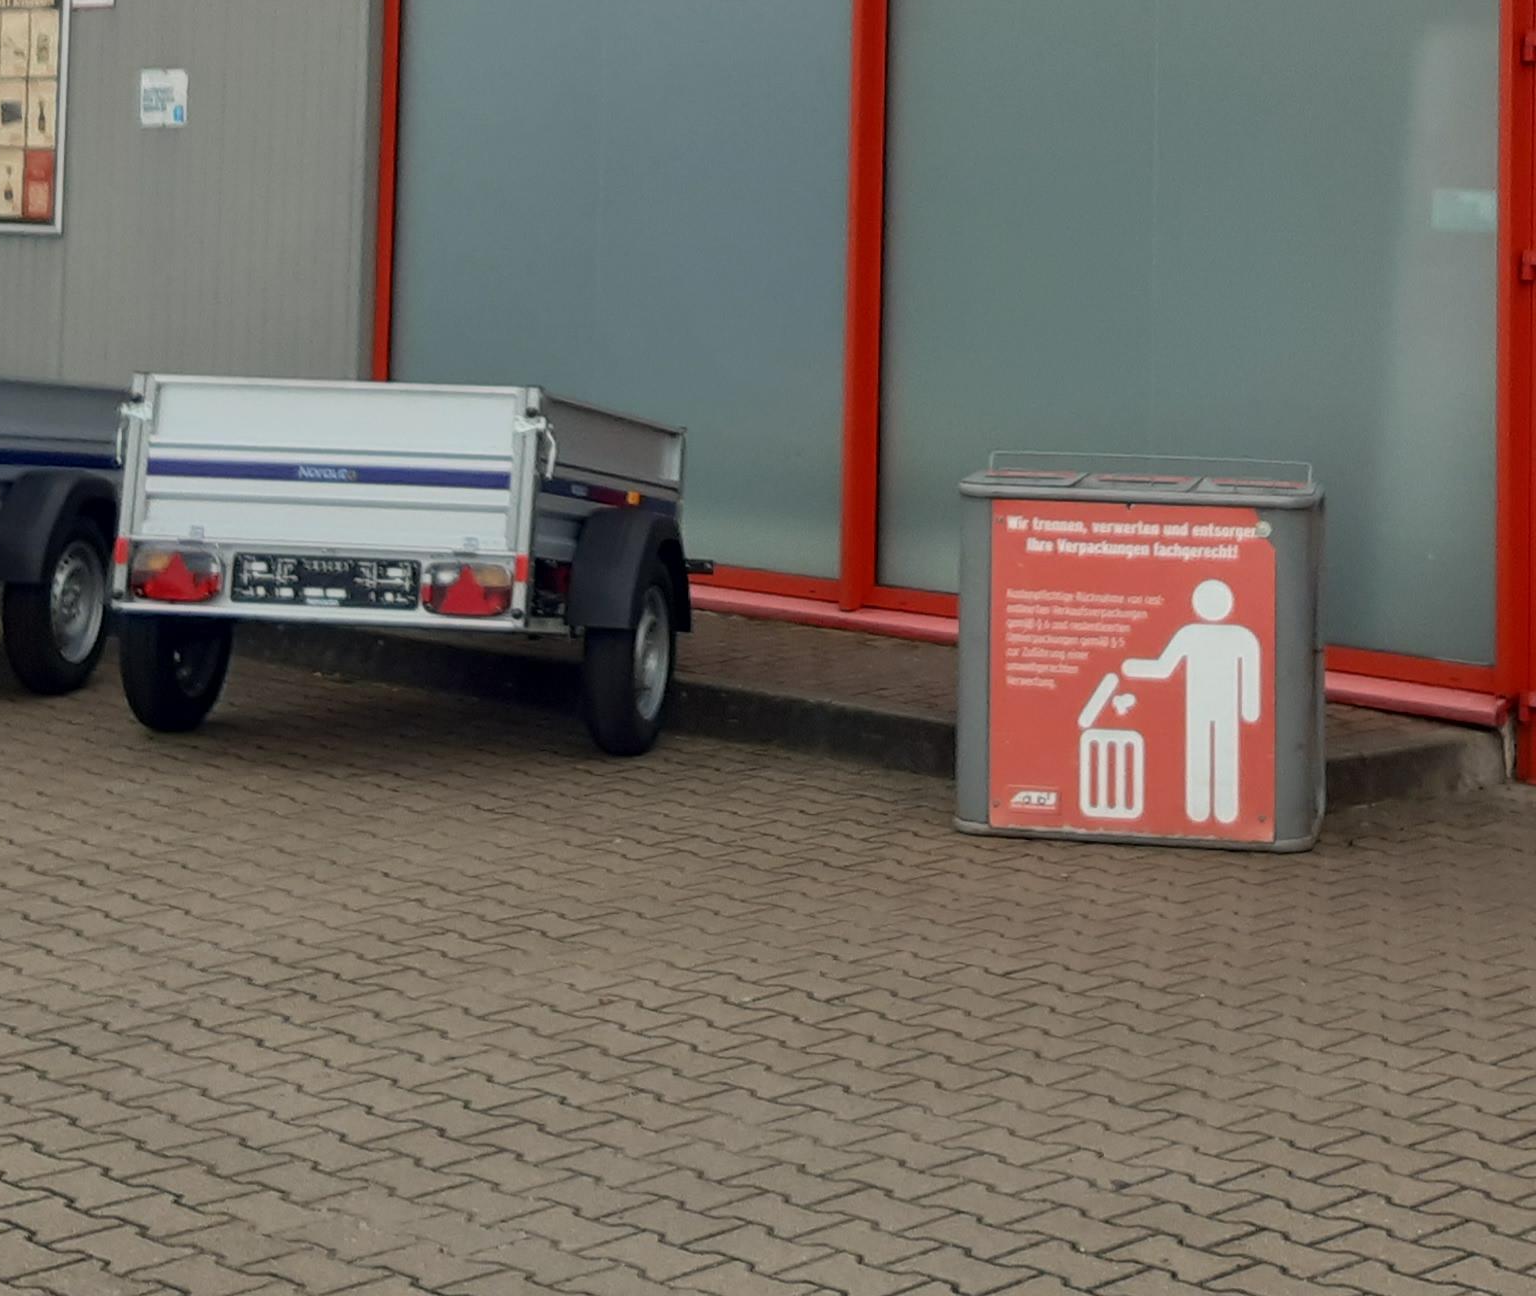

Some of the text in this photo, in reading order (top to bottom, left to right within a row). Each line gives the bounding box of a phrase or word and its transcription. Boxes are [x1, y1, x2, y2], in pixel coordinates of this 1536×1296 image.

[1006, 515, 1029, 531] Wir
[1032, 517, 1088, 534] trennen,
[1091, 520, 1160, 536] verwerten
[1163, 521, 1189, 537] und
[1026, 537, 1239, 561] Ihre Verpackungen fachgerecht!
